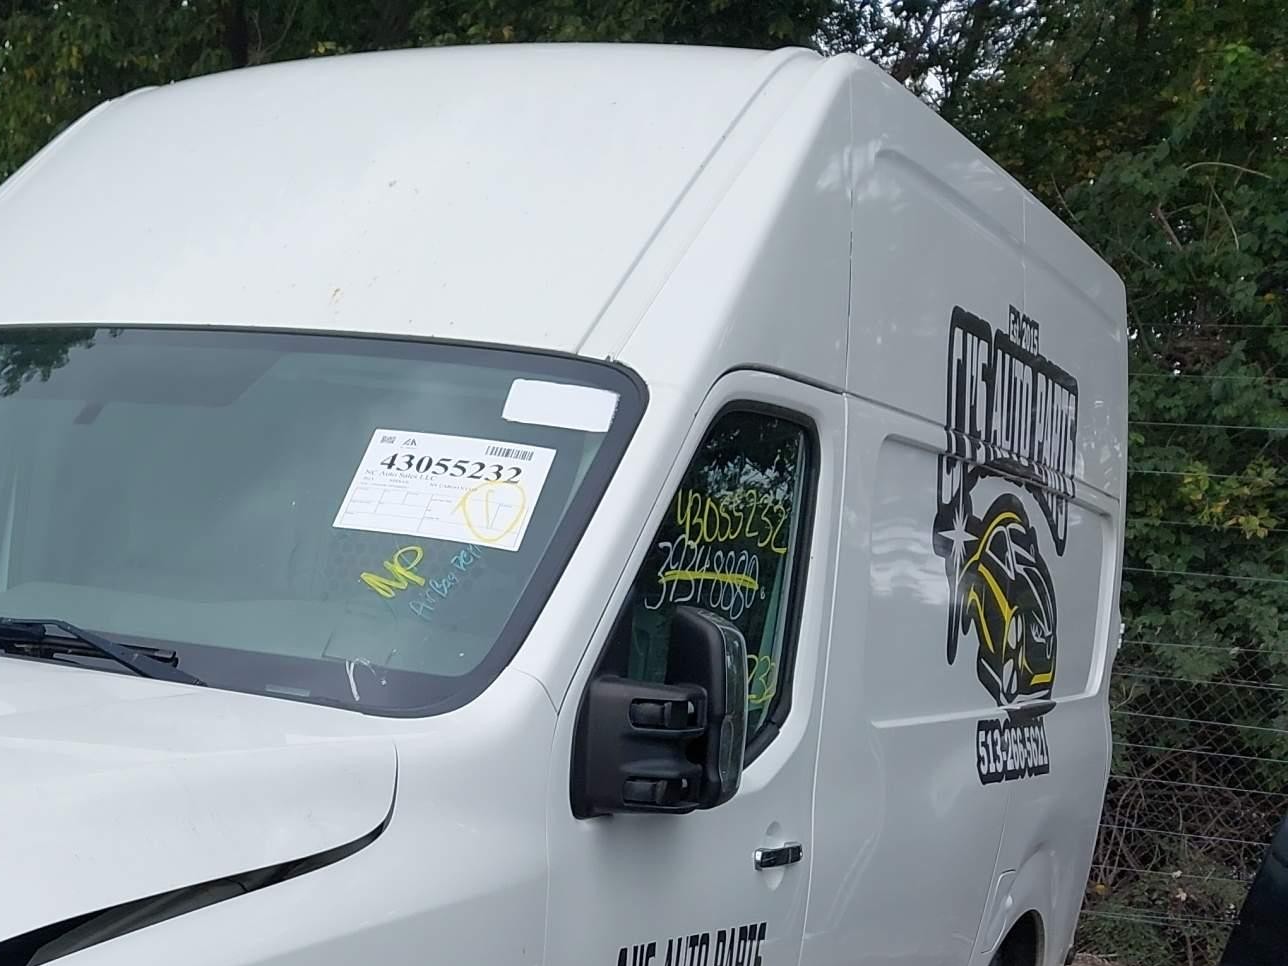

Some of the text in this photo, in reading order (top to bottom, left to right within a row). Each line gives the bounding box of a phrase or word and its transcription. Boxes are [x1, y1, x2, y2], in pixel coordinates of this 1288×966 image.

[1021, 321, 1038, 357] 2015
[380, 452, 523, 485] 43055232
[991, 348, 1033, 468] AUTO
[1033, 370, 1077, 542] PARTS
[676, 488, 789, 554] 43055232
[978, 726, 1049, 776] 513-266-5621
